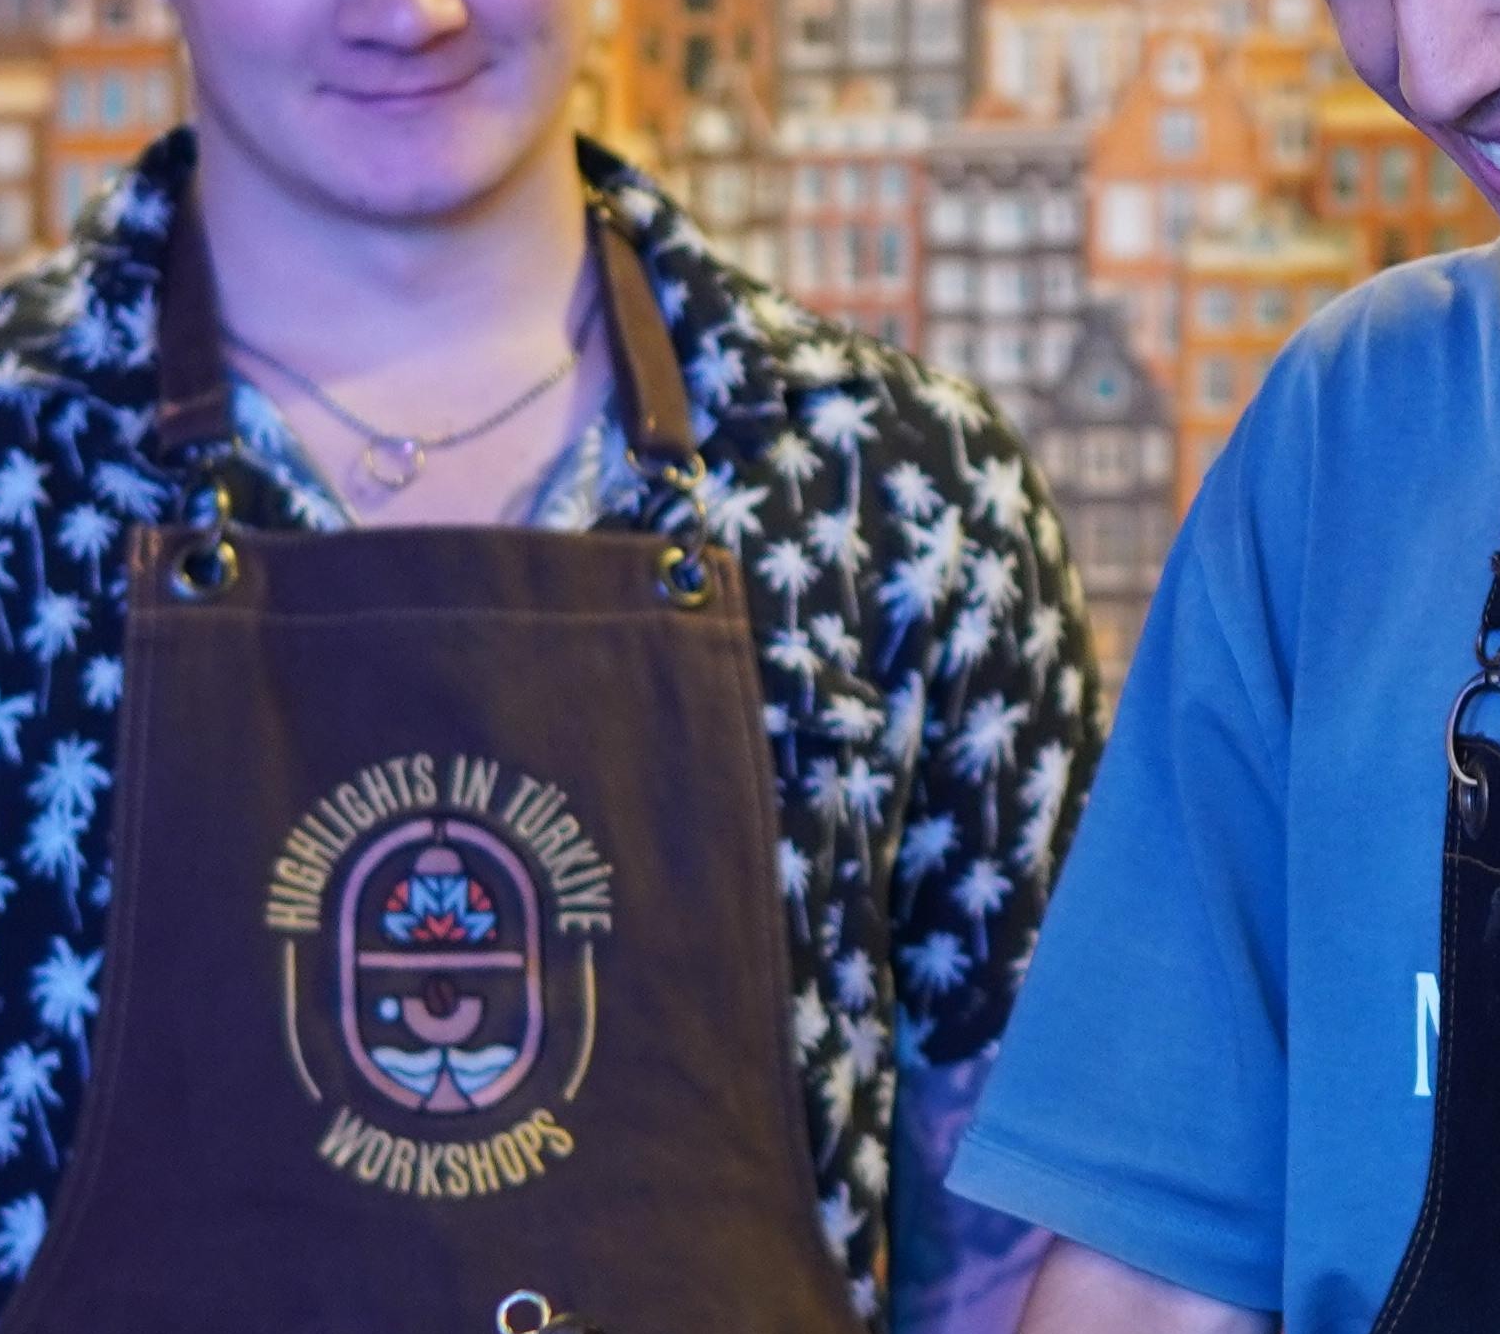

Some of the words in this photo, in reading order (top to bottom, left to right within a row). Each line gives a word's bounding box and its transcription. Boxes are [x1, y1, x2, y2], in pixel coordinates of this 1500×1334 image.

[266, 754, 437, 932] HIGHLIGHTS
[452, 755, 498, 812] IN
[319, 1106, 574, 1199] WORKSHOPS
